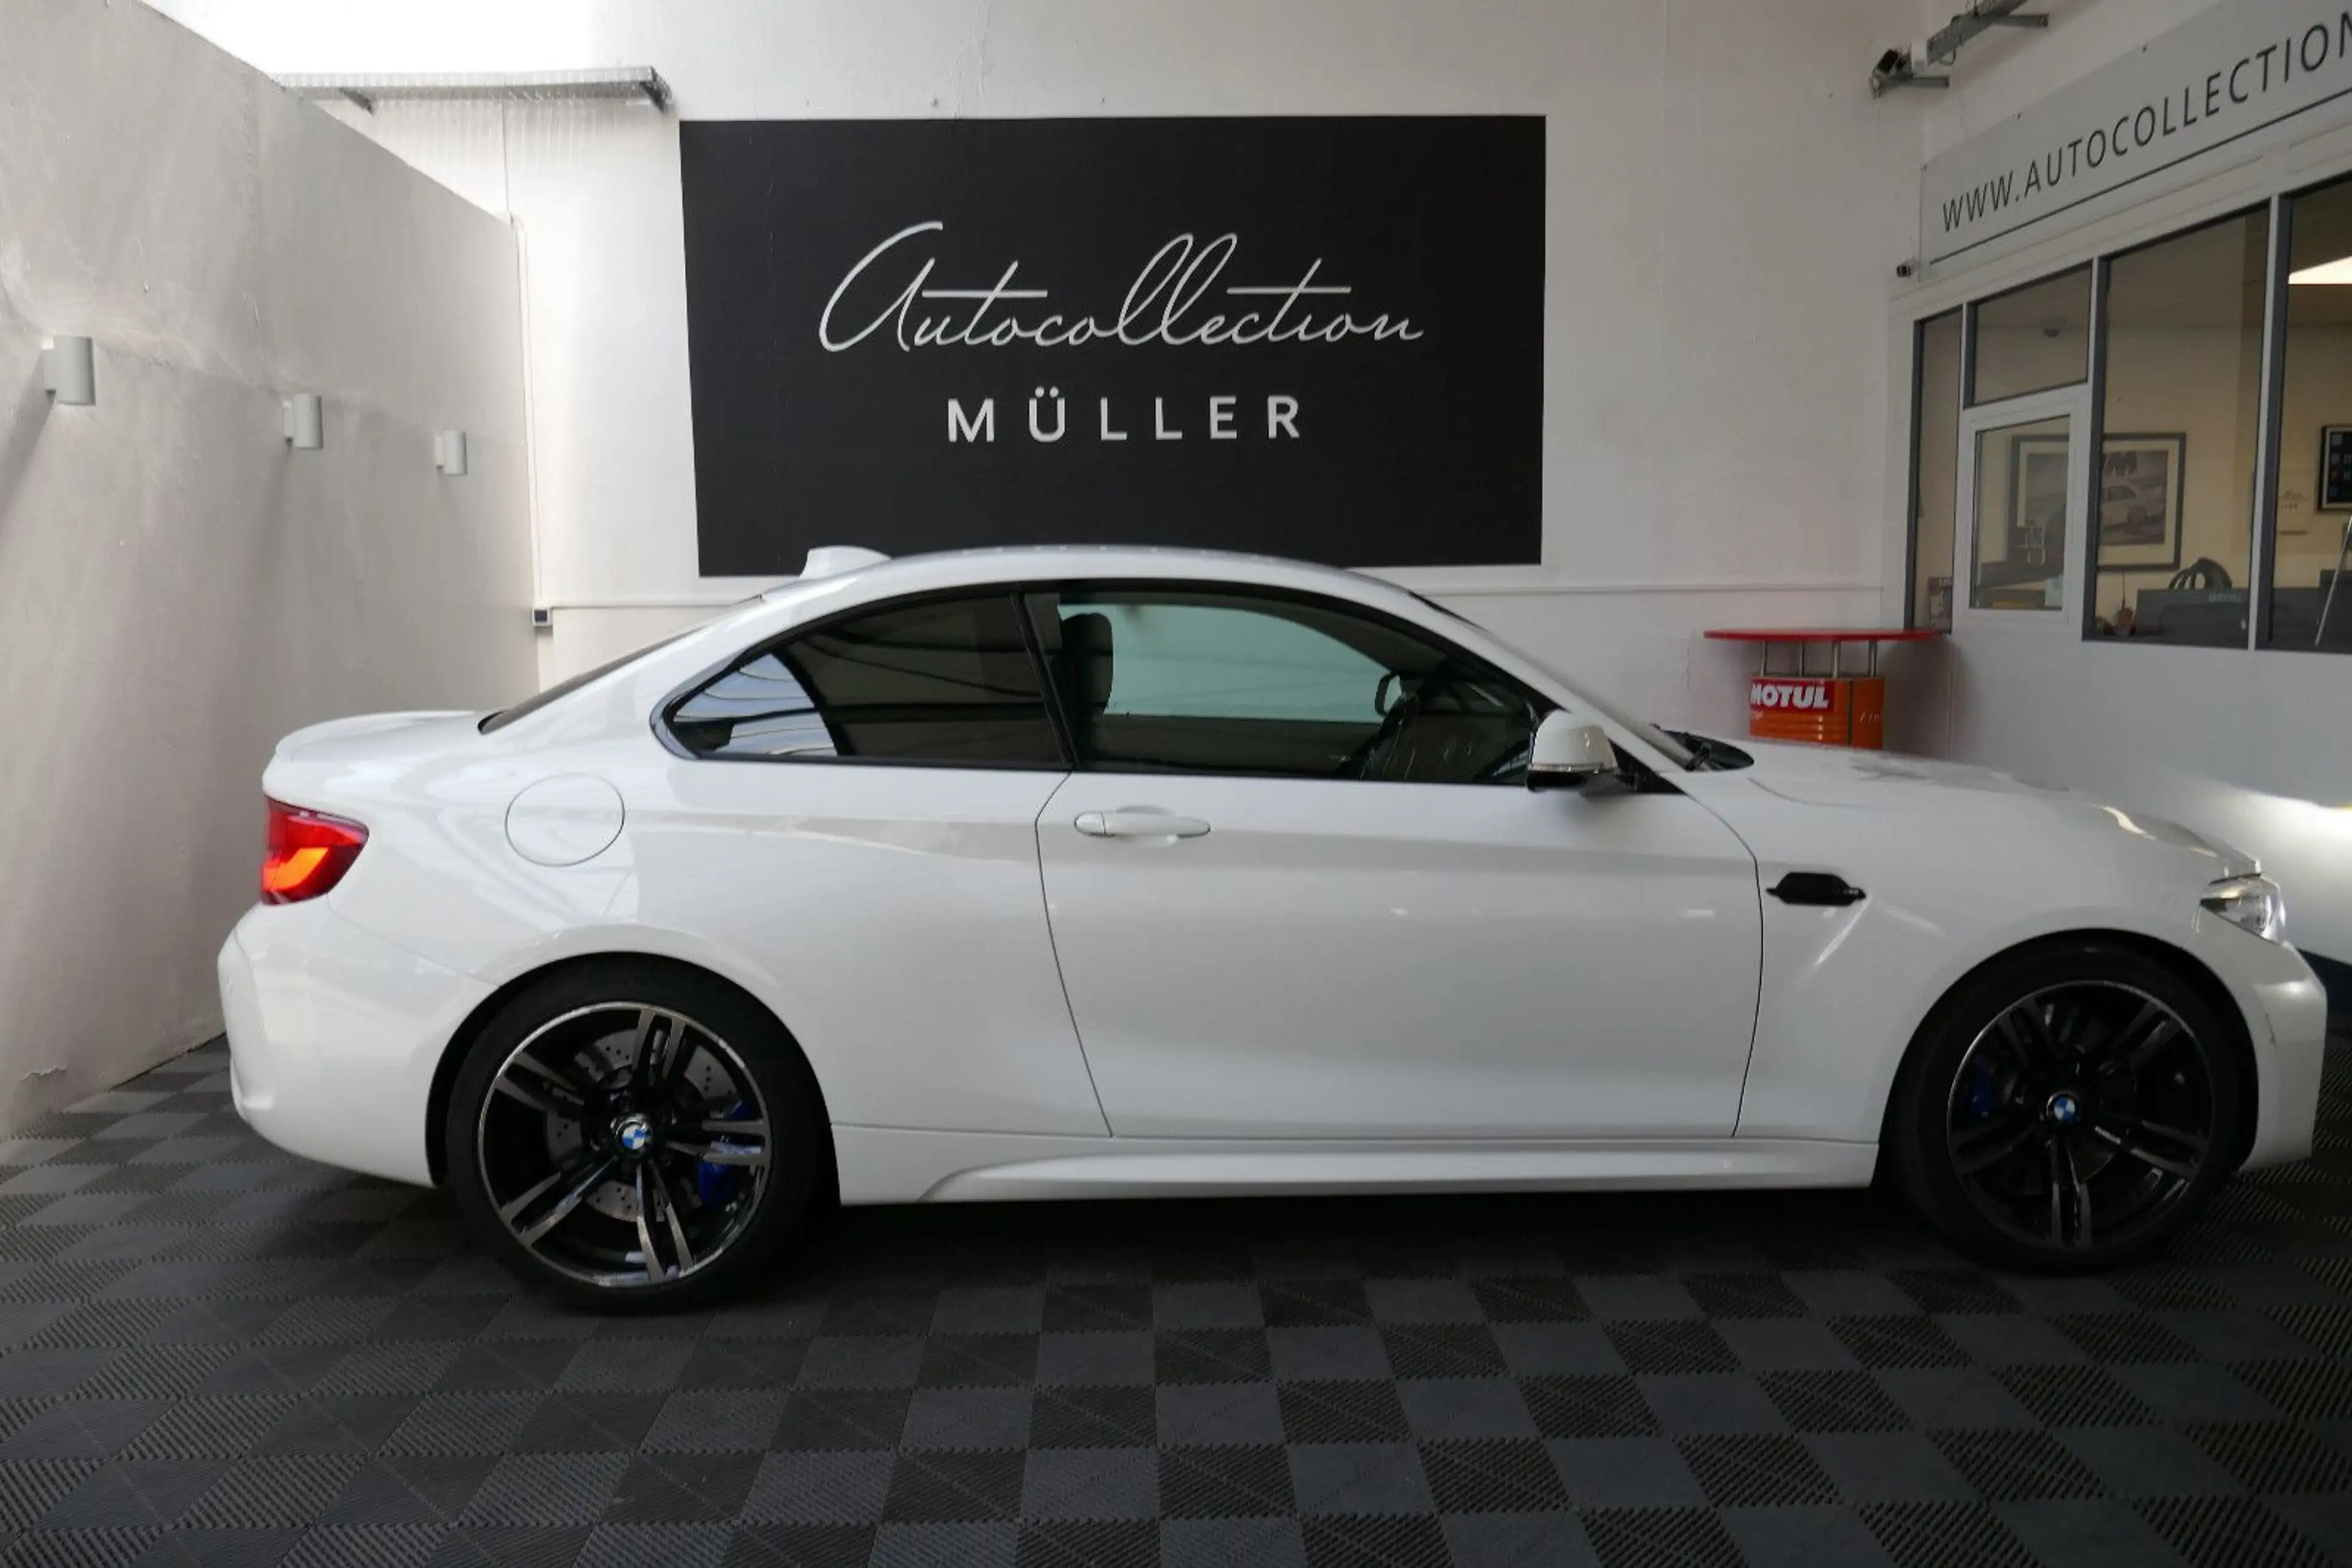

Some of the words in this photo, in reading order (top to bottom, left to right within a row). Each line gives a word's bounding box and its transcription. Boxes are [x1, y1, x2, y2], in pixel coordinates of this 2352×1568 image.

[819, 221, 1423, 352] Autocollection
[948, 386, 1299, 442] MÜLLER
[1751, 682, 1828, 709] MOTUL
